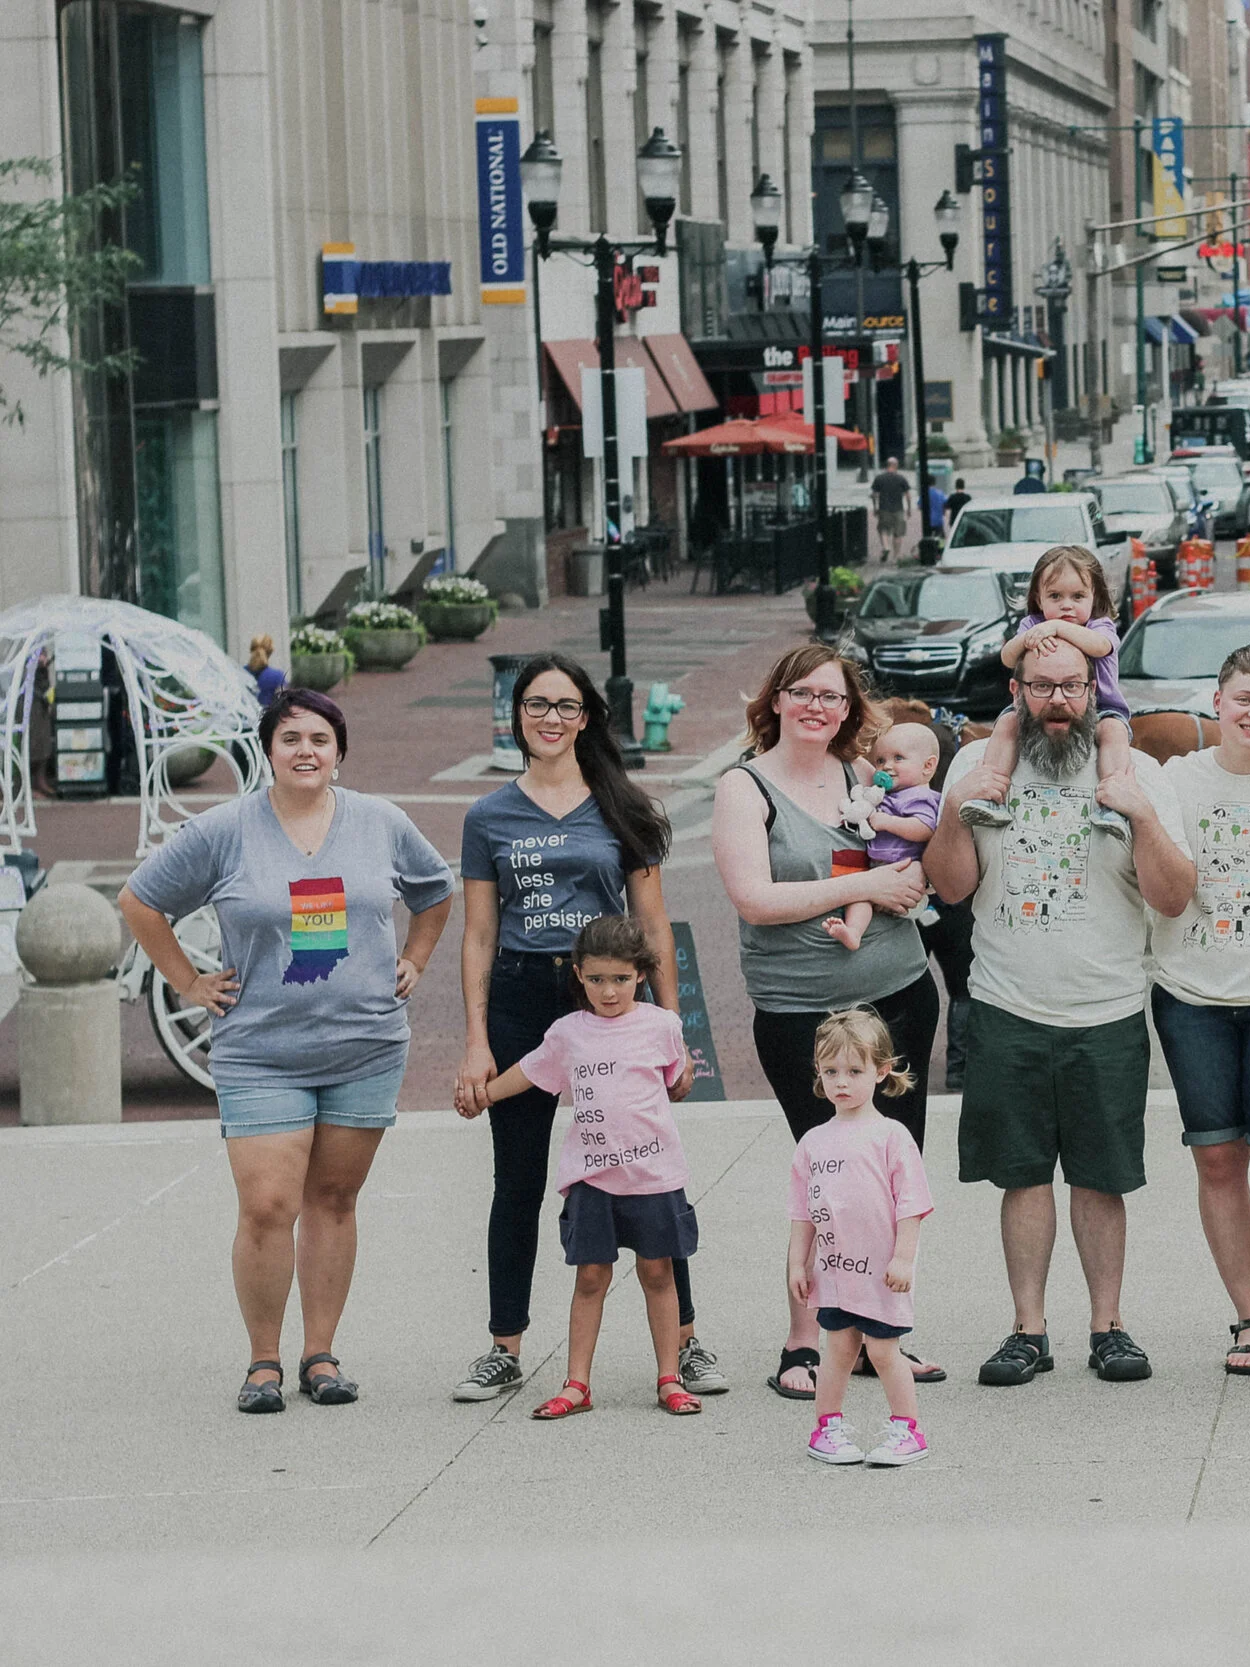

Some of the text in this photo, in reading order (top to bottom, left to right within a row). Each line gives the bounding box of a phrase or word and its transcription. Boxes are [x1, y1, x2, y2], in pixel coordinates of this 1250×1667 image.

[487, 129, 509, 276] OLD NATIONAL
[763, 345, 794, 367] the
[512, 833, 569, 849] never
[509, 851, 543, 869] the
[514, 872, 555, 890] less
[522, 891, 553, 909] she
[302, 913, 334, 926] YOU
[573, 1107, 605, 1124] less
[580, 1128, 606, 1146] she
[584, 1136, 665, 1172] persisted.
